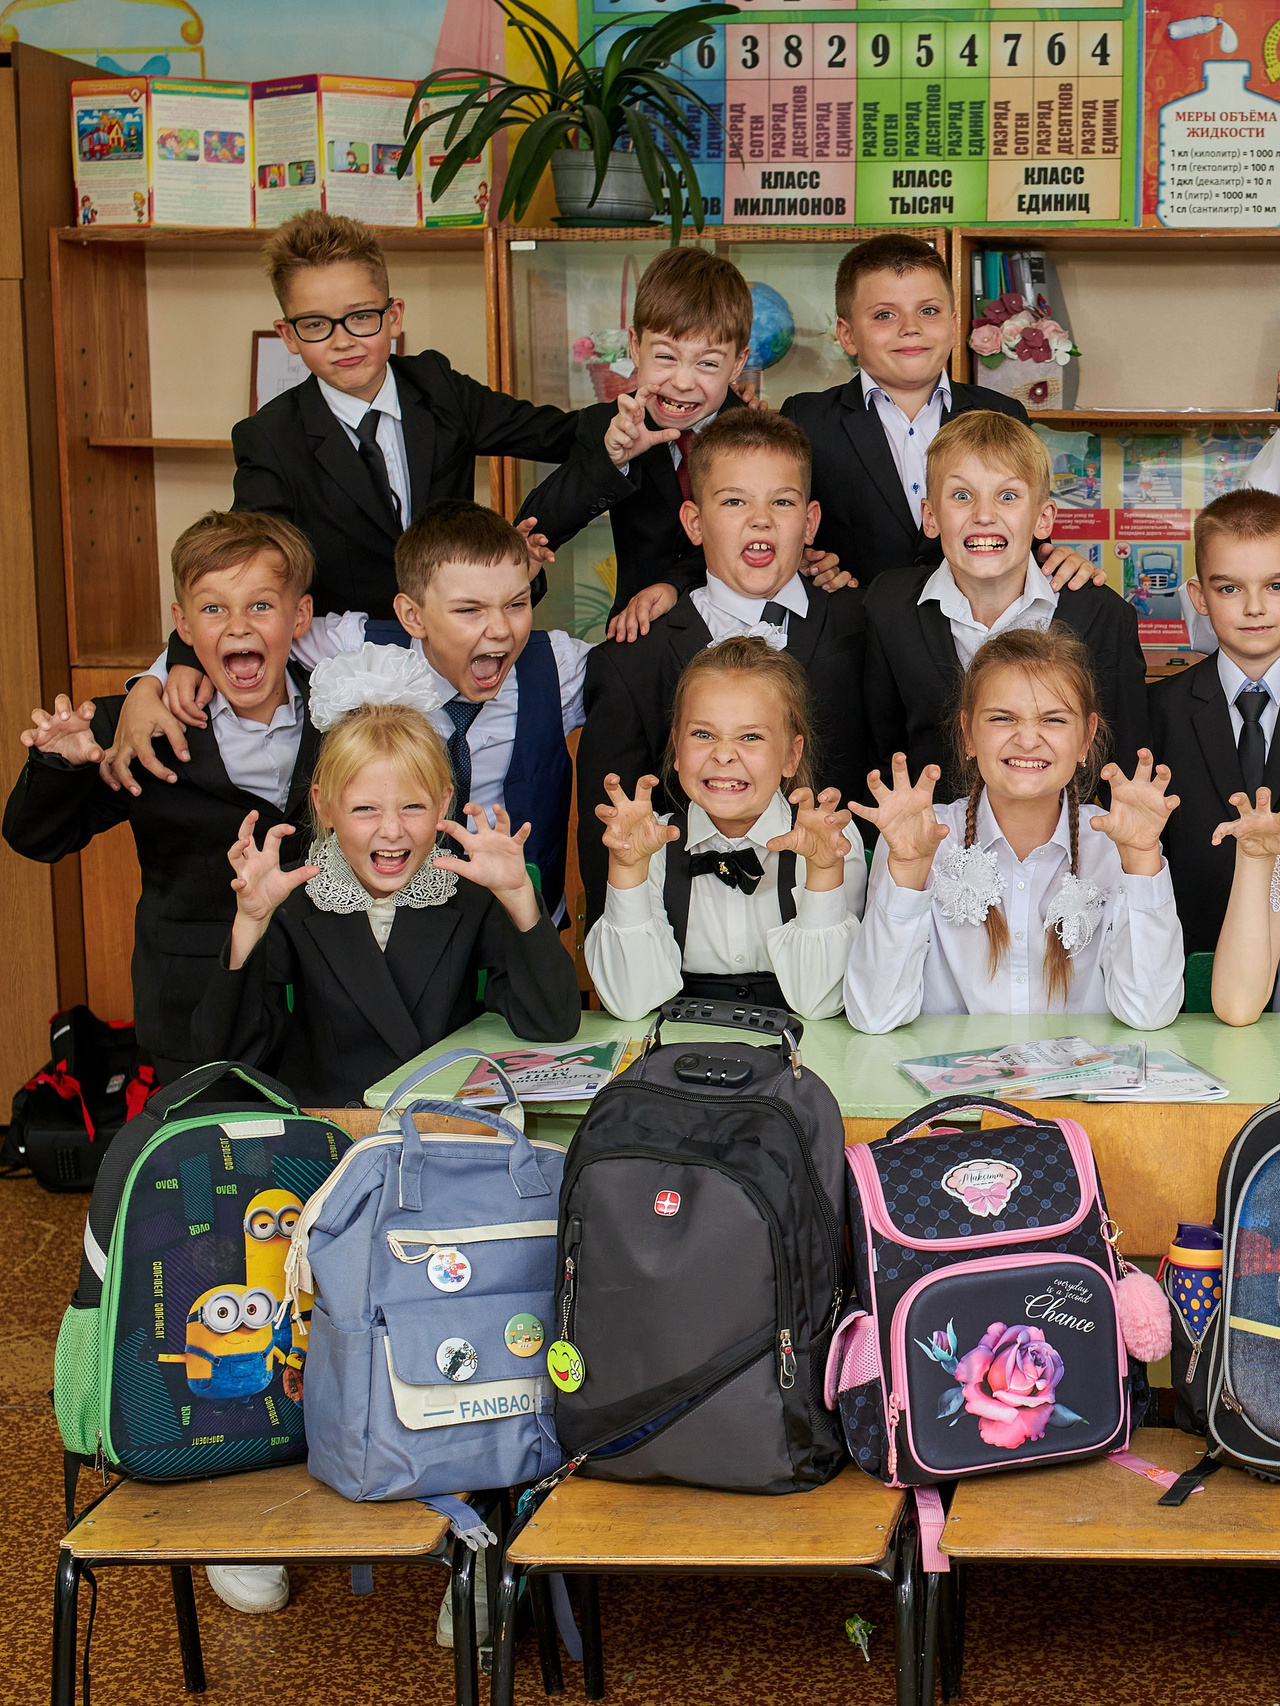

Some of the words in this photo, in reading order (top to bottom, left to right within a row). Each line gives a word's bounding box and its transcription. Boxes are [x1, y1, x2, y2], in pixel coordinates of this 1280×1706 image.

[697, 35, 715, 69] 6
[742, 35, 759, 69] 3
[784, 35, 802, 68] 8
[827, 35, 846, 68] 2
[871, 34, 890, 67] 9
[916, 33, 934, 67] 5
[960, 34, 978, 67] 4
[1003, 34, 1022, 66] 7
[1047, 32, 1066, 66] 6
[1091, 33, 1110, 66] 4
[729, 103, 746, 159] РАЗРЯД
[772, 102, 788, 158] РАЗРЯД
[793, 85, 808, 158] ДЕСЯТКОВ
[816, 102, 832, 157] РАЗРЯД
[837, 101, 853, 157] ЕДИНИЦ
[863, 101, 880, 157] РАЗРЯД
[905, 101, 922, 156] РАЗРЯД
[926, 84, 942, 156] ДЕСЯТКОВ
[948, 101, 964, 156] РАЗРЯД
[969, 100, 985, 156] ЕДИНИЦ
[993, 100, 1010, 155] РАЗРЯД
[1037, 100, 1053, 155] РАЗРЯД
[1058, 83, 1074, 155] ДЕСЯТКОВ
[1082, 100, 1098, 155] РАЗРЯД
[1102, 99, 1119, 154] ЕДИНИЦ
[1175, 112, 1215, 121] МЕРЫ
[1219, 110, 1277, 121] ОБЪЁМА
[750, 115, 764, 158] СОТЕН
[883, 114, 898, 156] СОТЕН
[1014, 112, 1029, 155] СОТЕН
[1187, 128, 1264, 139] ЖИДКОСТИ
[1190, 148, 1240, 159] (килолитр)
[1190, 162, 1242, 173] (гектолитр)
[761, 170, 820, 190] КЛАСС
[893, 169, 952, 188] КЛАСС
[1024, 166, 1085, 185] КЛАСС
[1177, 178, 1193, 186] дкл
[1196, 176, 1244, 187] (декалитр)
[733, 198, 846, 216] МИЛЛИОНОВ
[889, 196, 954, 215] ТЫСЯЧ
[1017, 193, 1090, 214] ЕДИНИЦ
[1185, 190, 1212, 200] (литр)
[1189, 204, 1242, 214] (сантилитр)
[219, 1137, 234, 1170] CONFIDENT
[156, 1179, 178, 1190] OVER
[216, 1184, 238, 1195] OVER
[188, 1223, 210, 1236] OVER
[153, 1261, 163, 1298] CONFIDENT
[1054, 1279, 1089, 1295] everyday
[1065, 1291, 1093, 1304] second
[155, 1303, 165, 1339] CONFIDENT
[1025, 1294, 1095, 1333] Chance
[181, 1406, 191, 1426] OVER
[264, 1396, 280, 1426] CONFIDENT
[460, 1393, 530, 1419] FANBAO
[192, 1434, 224, 1446] CONFIDENT
[271, 1436, 289, 1446] OVER
